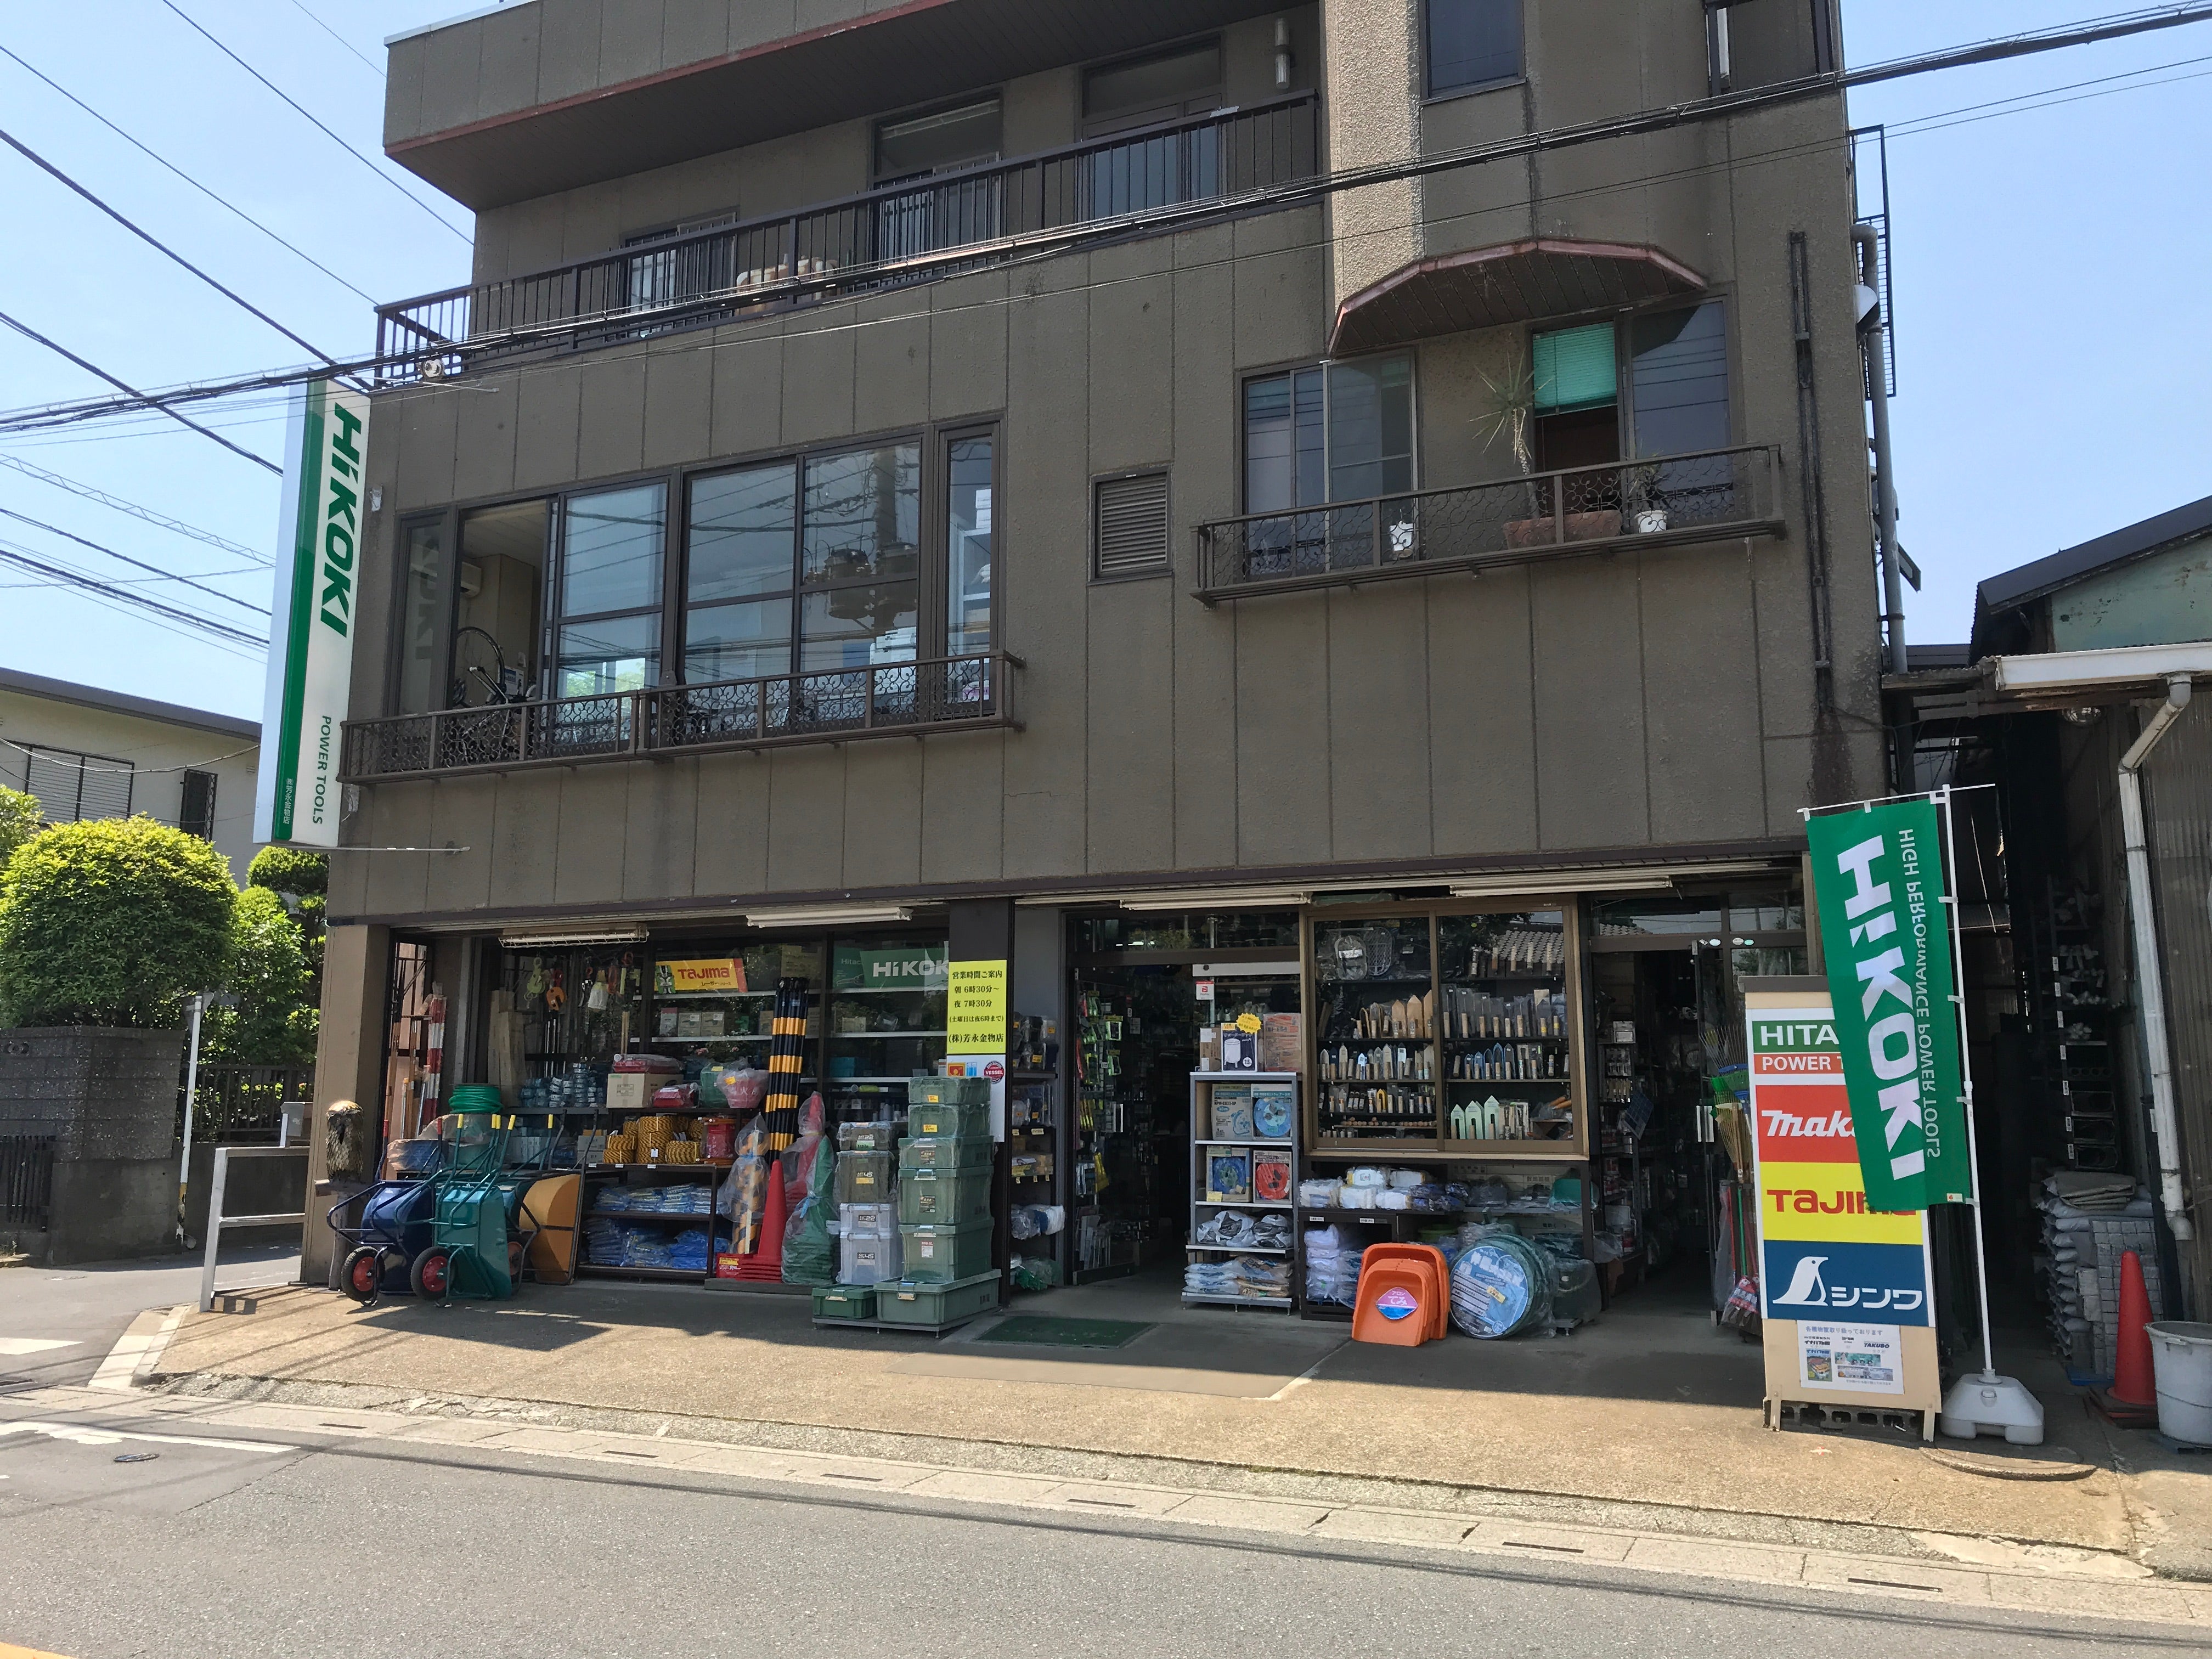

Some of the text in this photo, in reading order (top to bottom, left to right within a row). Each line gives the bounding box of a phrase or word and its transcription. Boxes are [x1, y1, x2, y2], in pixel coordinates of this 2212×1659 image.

[313, 715, 331, 824] POWER TOOLS
[873, 960, 949, 977] HiKOK
[952, 970, 1002, 979] 営業時間ご案内
[949, 1034, 1004, 1043] (株)芳永金物店
[1760, 1025, 1839, 1046] HITA
[1762, 1056, 1831, 1071] POWER
[1762, 1110, 1856, 1137] mak
[1387, 1296, 1408, 1306] てみ
[1831, 1286, 1922, 1310] シンワ
